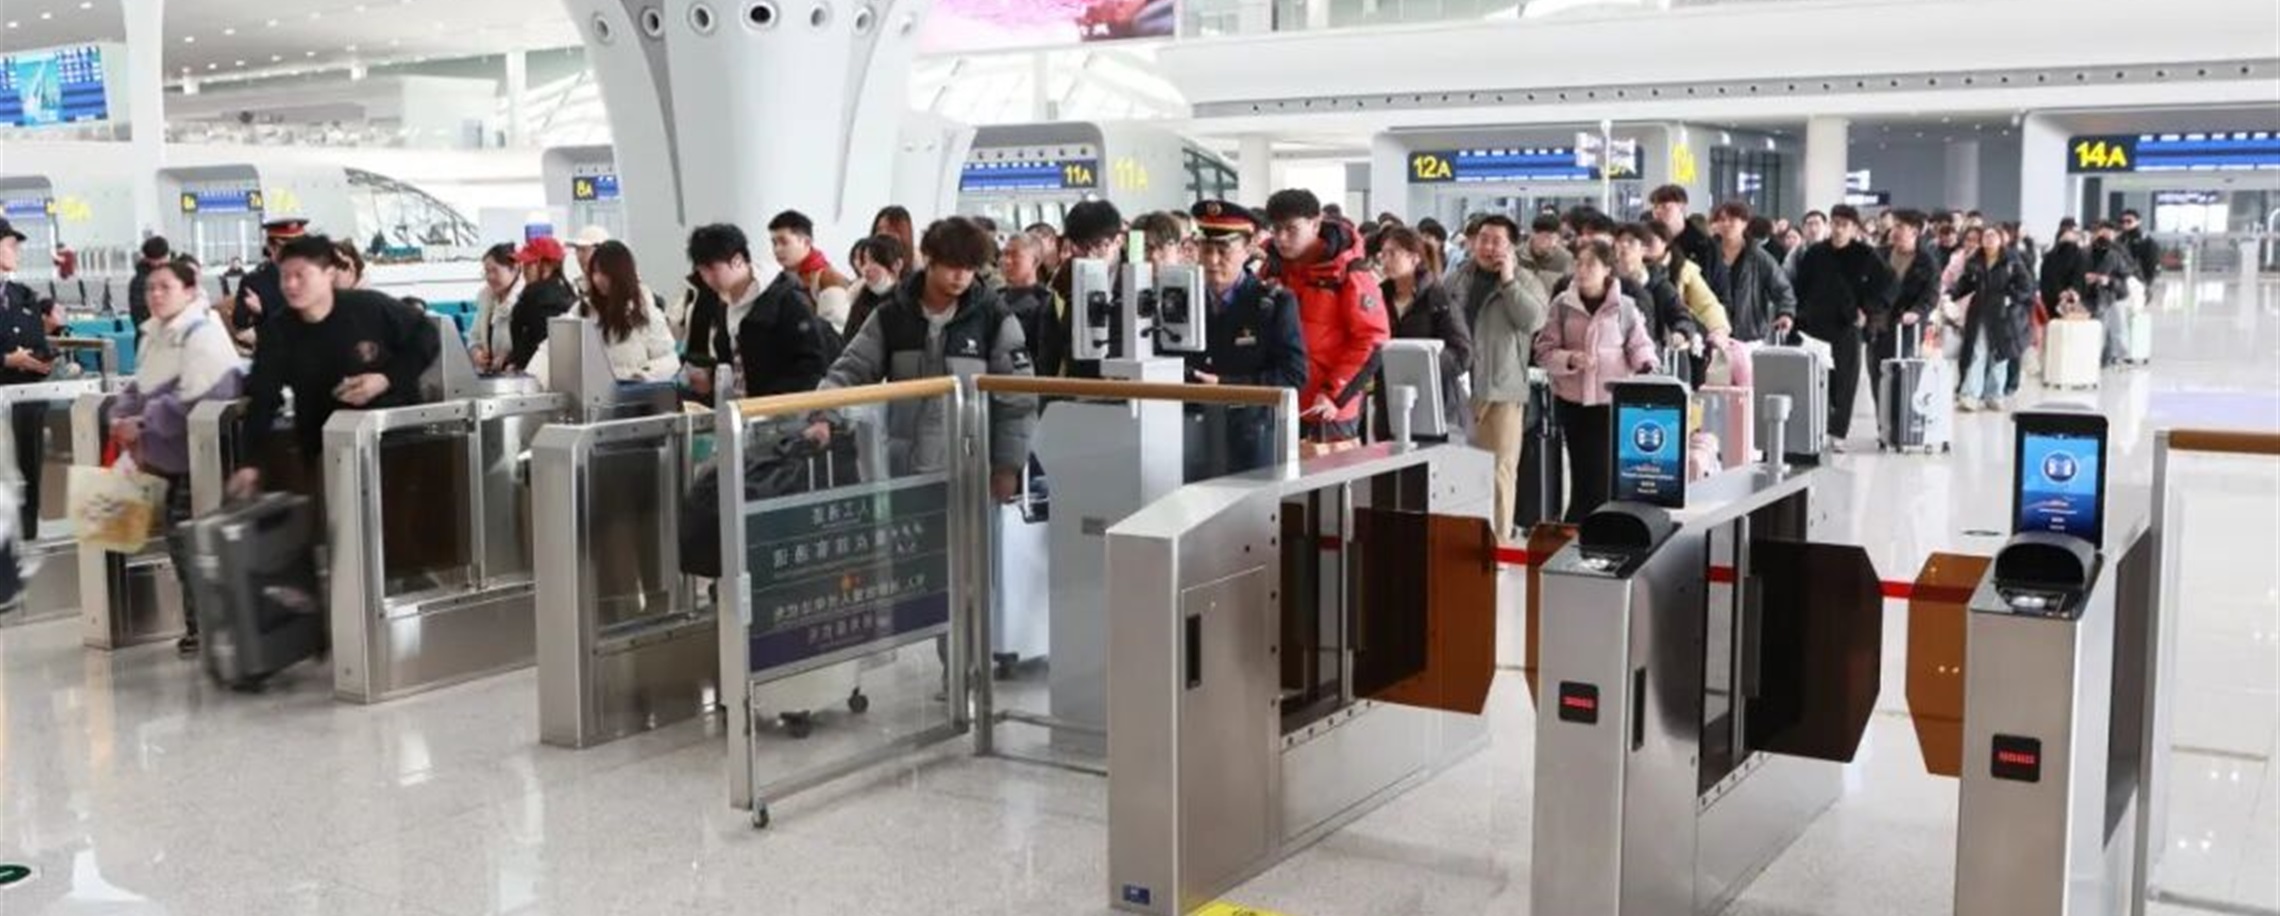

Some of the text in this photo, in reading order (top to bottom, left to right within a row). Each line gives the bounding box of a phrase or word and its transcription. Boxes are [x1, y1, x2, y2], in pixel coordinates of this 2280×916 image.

[2075, 141, 2127, 168] 14A
[1064, 165, 1092, 185] 11A
[1114, 156, 1148, 190] 11A
[1413, 156, 1452, 178] 12A
